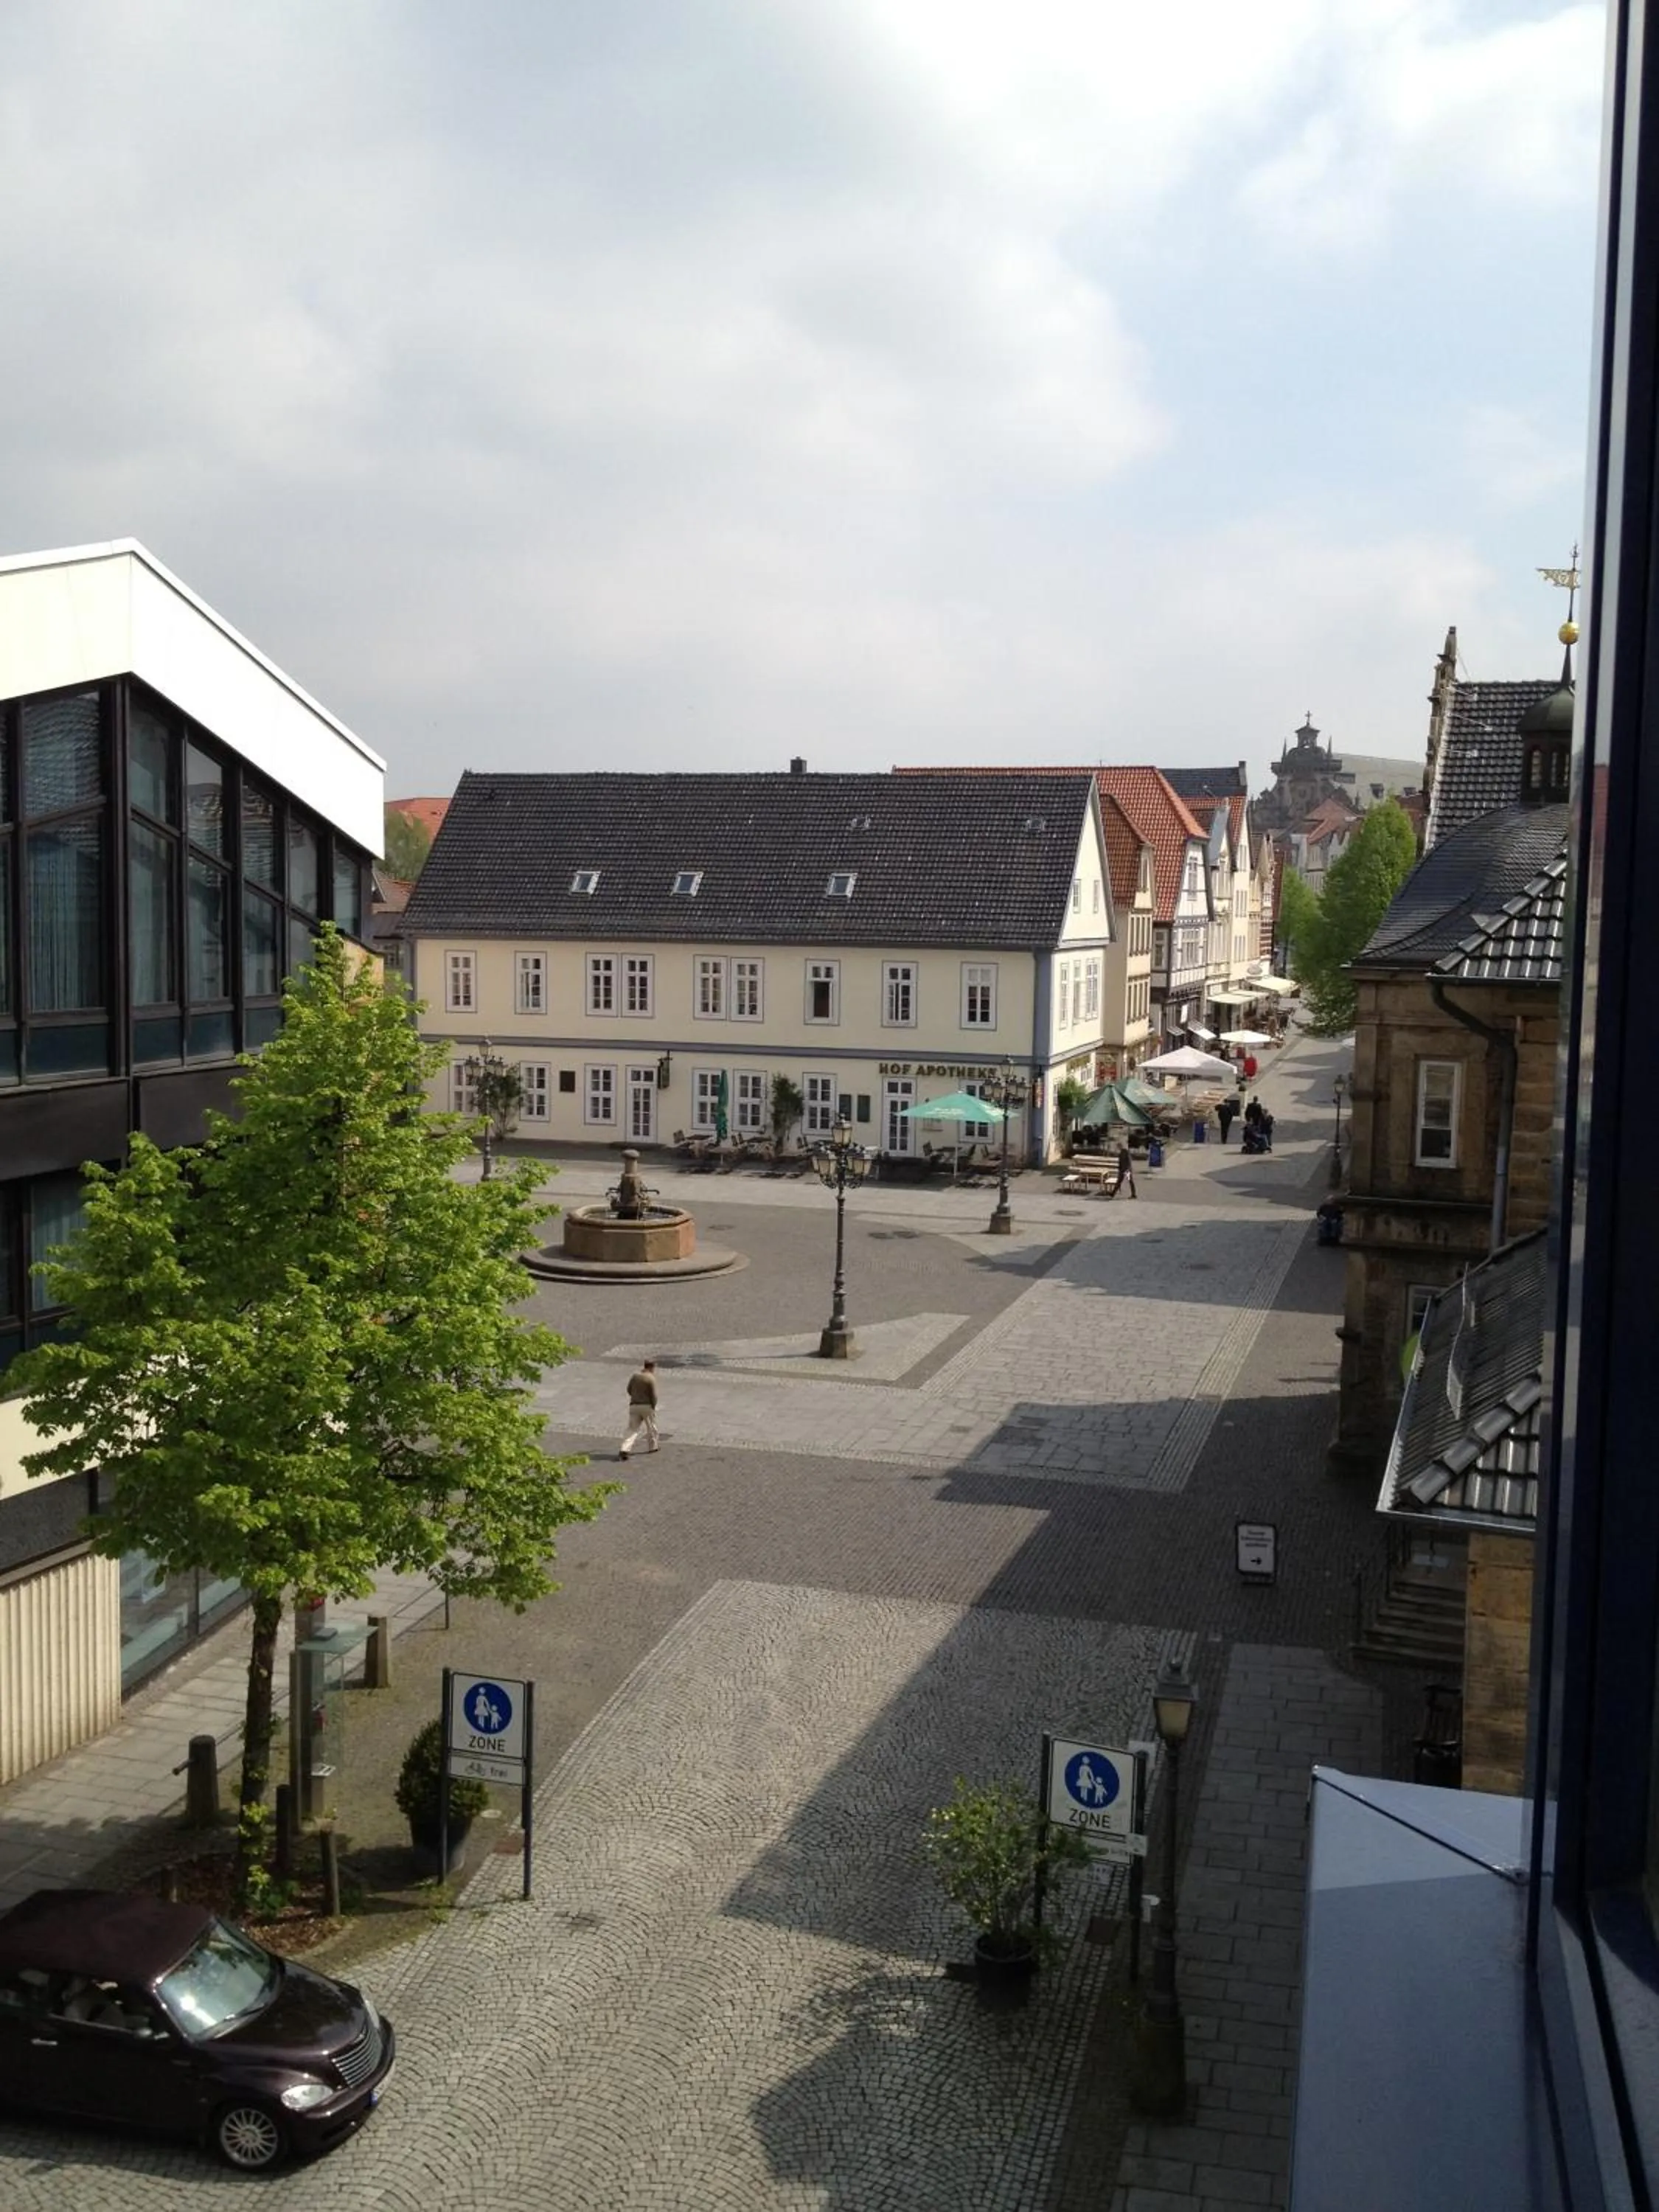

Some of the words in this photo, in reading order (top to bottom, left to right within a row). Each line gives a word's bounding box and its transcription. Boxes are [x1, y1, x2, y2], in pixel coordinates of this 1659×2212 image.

[879, 1062, 911, 1074] HOF
[916, 1064, 997, 1079] APOTHEKE
[468, 1735, 507, 1753] ZONE
[1069, 1807, 1111, 1829] ZONE
